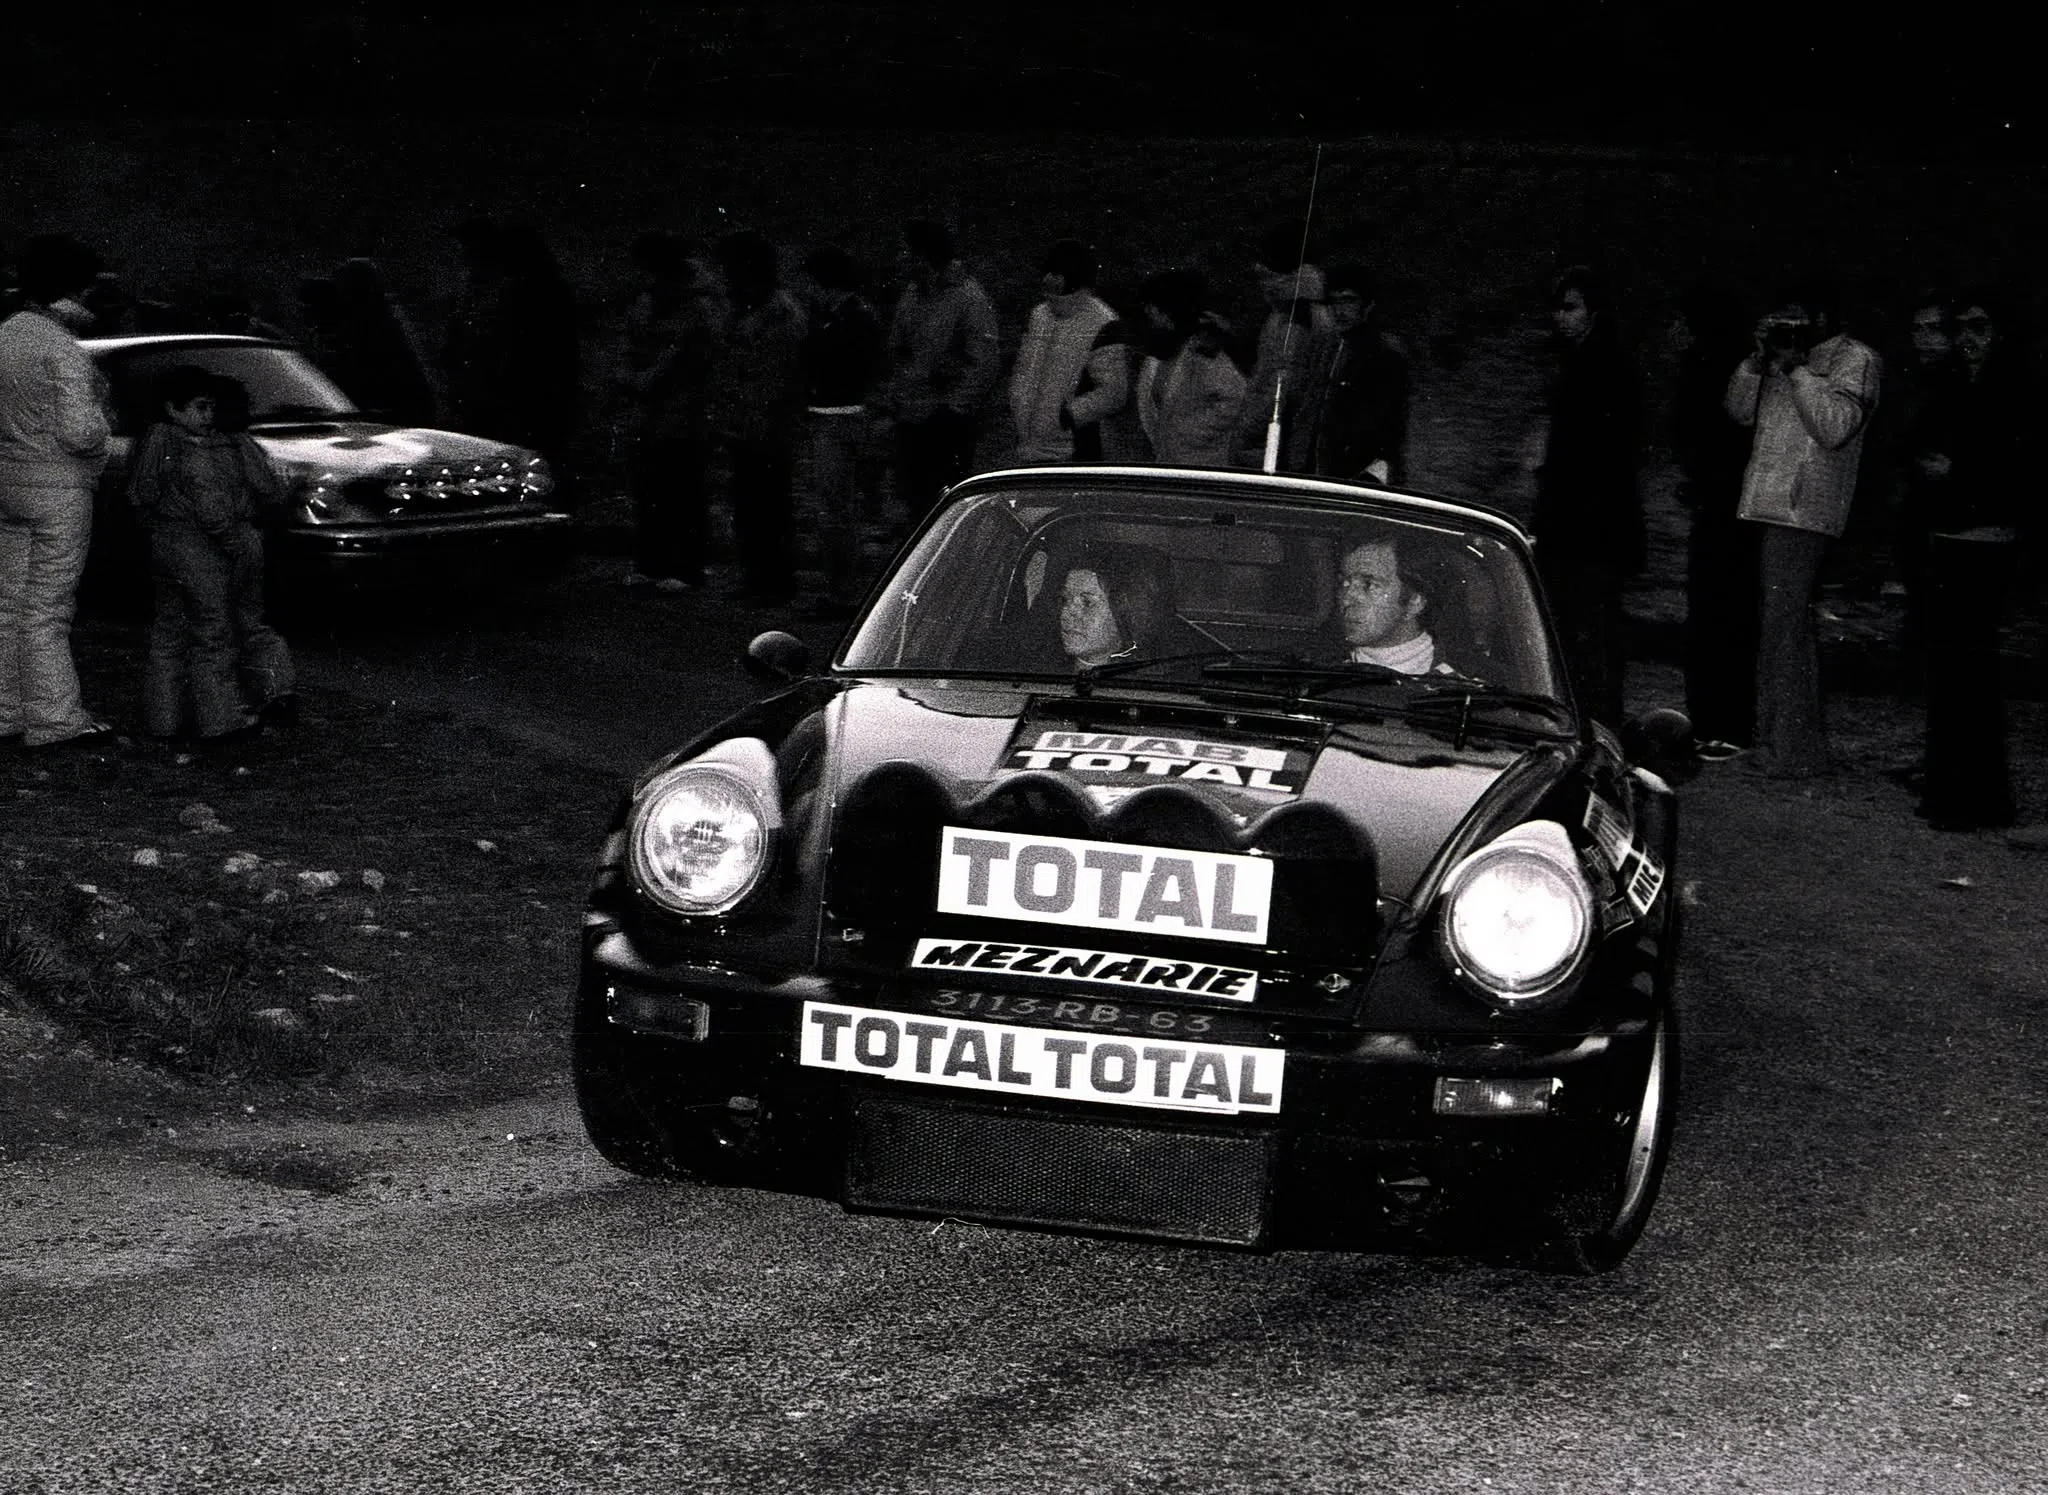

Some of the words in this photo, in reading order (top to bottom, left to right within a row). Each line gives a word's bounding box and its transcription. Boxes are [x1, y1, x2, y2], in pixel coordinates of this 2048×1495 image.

[1016, 751, 1293, 793] TOTAL
[1046, 733, 1247, 763] MAB
[953, 836, 1259, 934] TOTAL
[920, 943, 1257, 998] MEZNARIE
[930, 988, 1214, 1033] 3113-RB-63
[811, 1010, 1033, 1086] TOTAL
[1043, 1036, 1274, 1107] TOTAL
